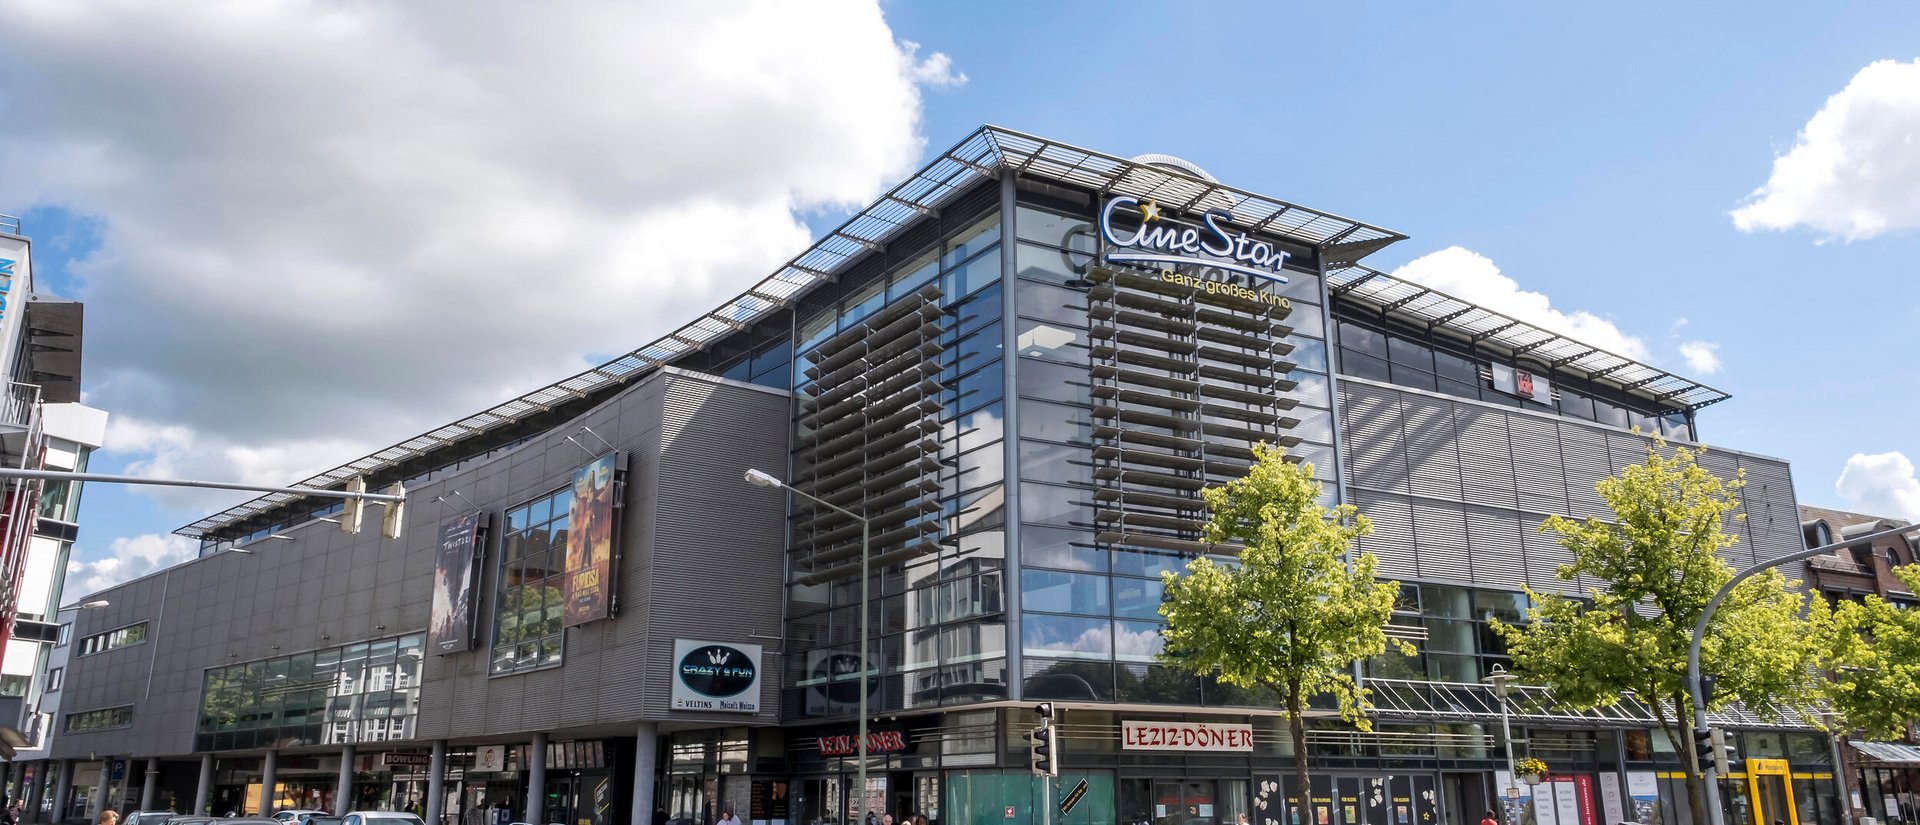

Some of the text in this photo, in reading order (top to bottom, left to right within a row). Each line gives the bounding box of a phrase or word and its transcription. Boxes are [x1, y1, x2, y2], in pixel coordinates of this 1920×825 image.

[1161, 269, 1291, 309] Ganz großes Kino
[683, 665, 720, 674] CRAZY
[733, 667, 752, 676] FUN
[685, 700, 713, 709] VELTINS
[1125, 724, 1253, 748] LEZIZ-DÖNER
[386, 755, 429, 764] BOWLING
[115, 762, 123, 772] P
